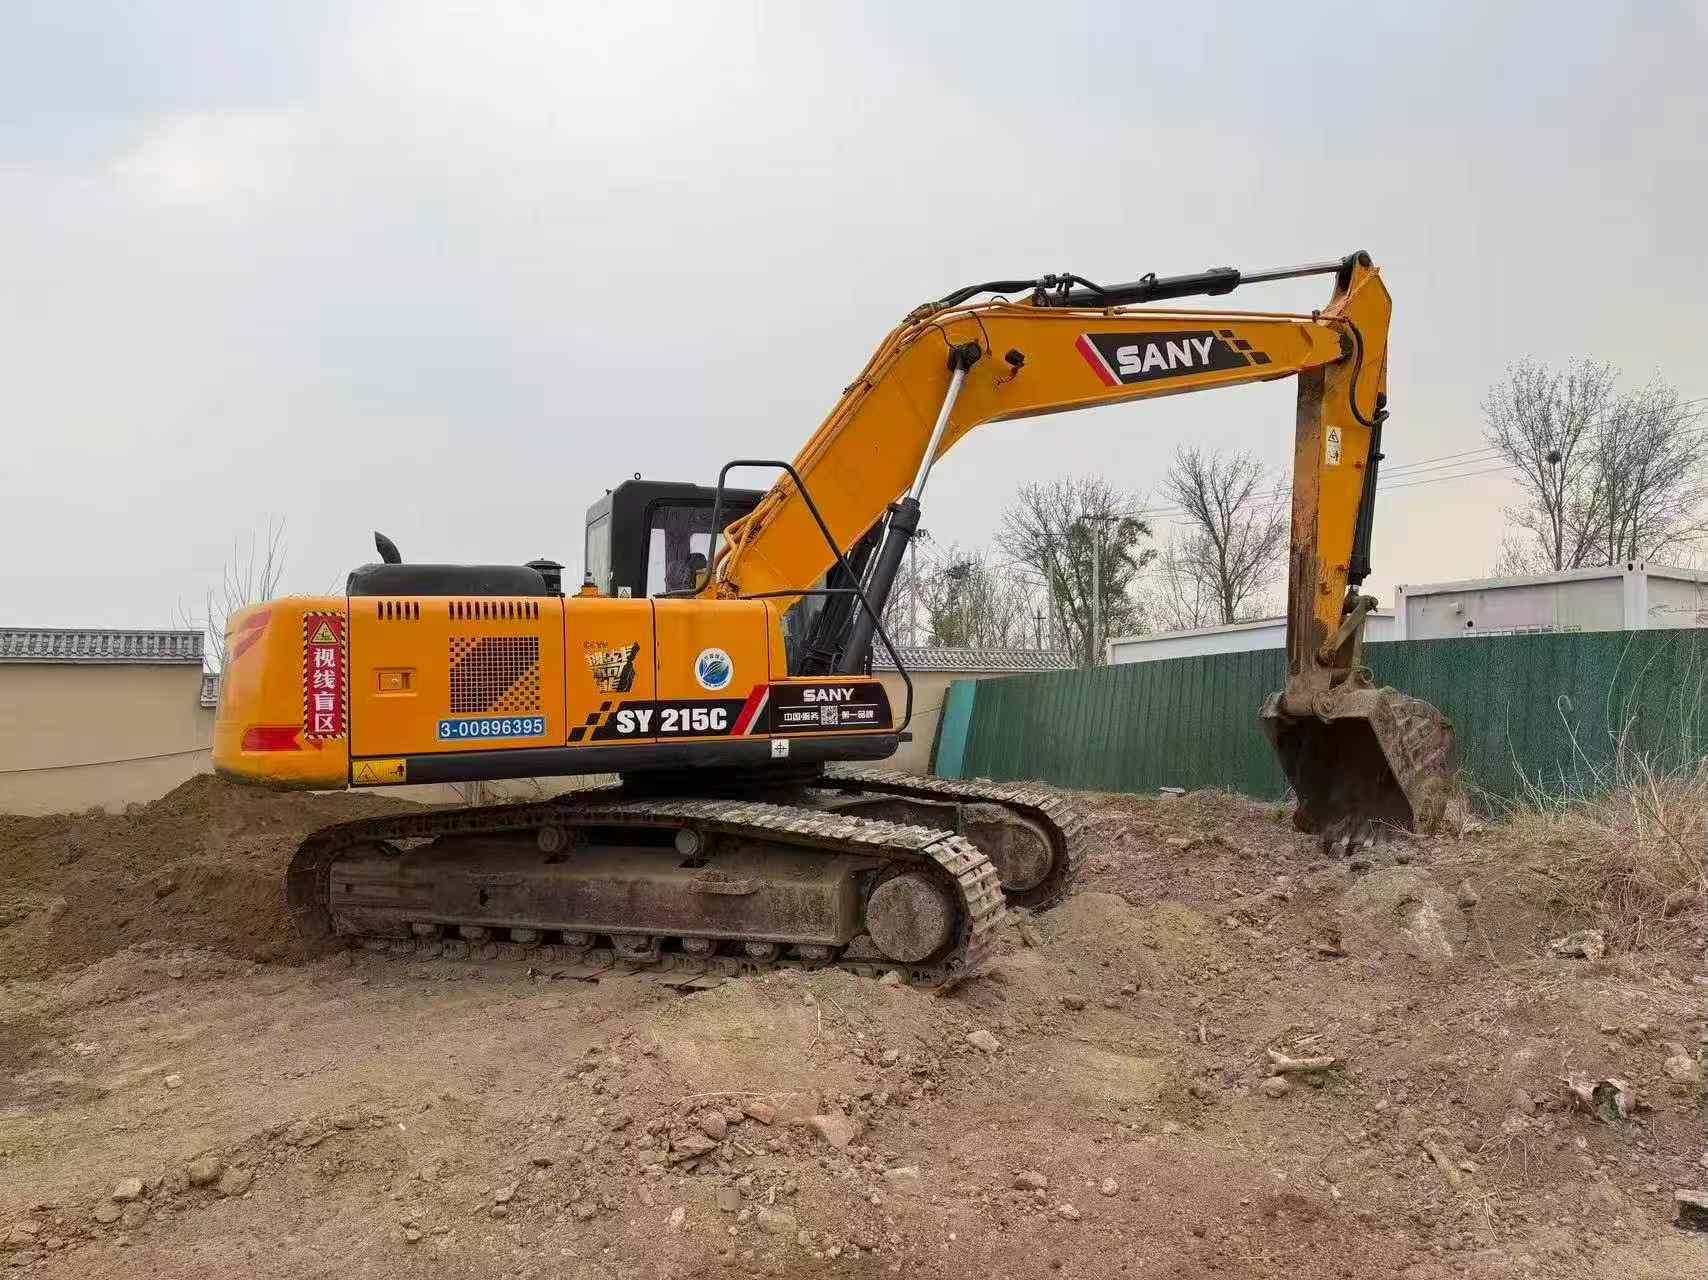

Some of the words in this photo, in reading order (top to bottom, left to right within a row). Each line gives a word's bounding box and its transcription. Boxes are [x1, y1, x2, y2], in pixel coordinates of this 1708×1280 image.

[1116, 336, 1214, 376] SANY
[313, 647, 336, 733] 视线盲区
[803, 687, 855, 702] SANY
[440, 719, 543, 738] 3-00896395
[616, 709, 653, 734] SY
[660, 707, 728, 732] 215C
